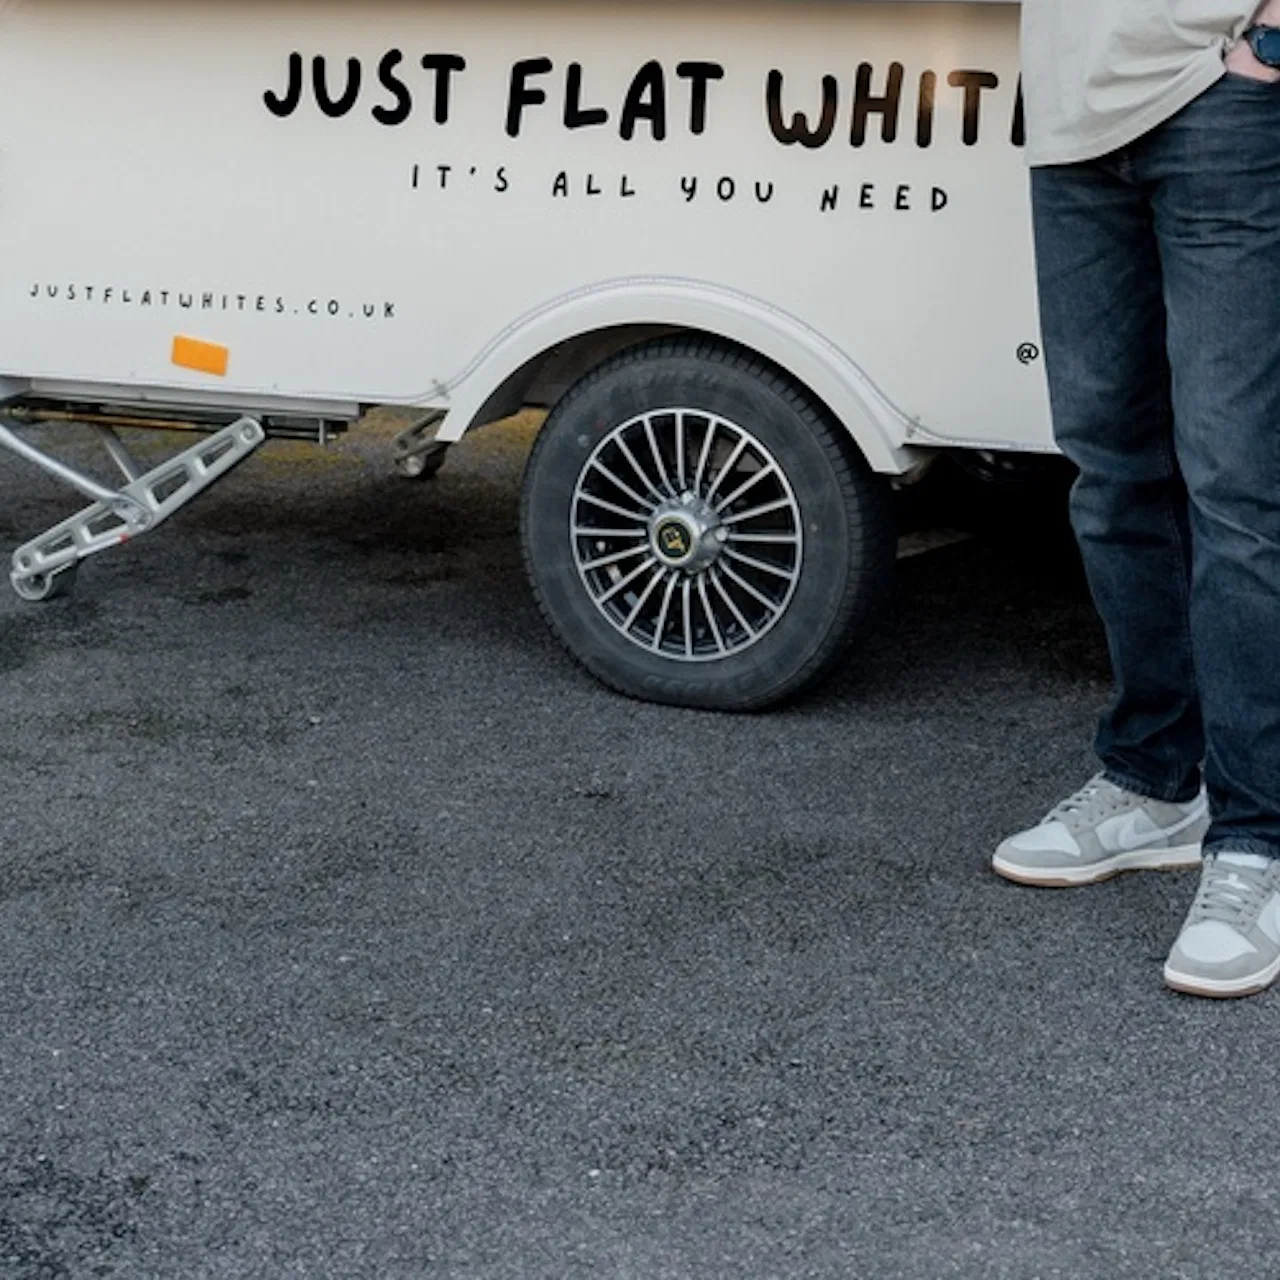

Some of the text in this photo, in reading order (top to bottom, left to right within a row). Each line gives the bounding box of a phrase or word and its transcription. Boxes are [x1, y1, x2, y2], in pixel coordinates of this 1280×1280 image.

[263, 48, 1026, 150] JUST FLAT WHIT
[412, 164, 948, 212] IT'S ALL YOU NEED
[29, 283, 395, 318] JUSTFLATWHITES.CO.UK
